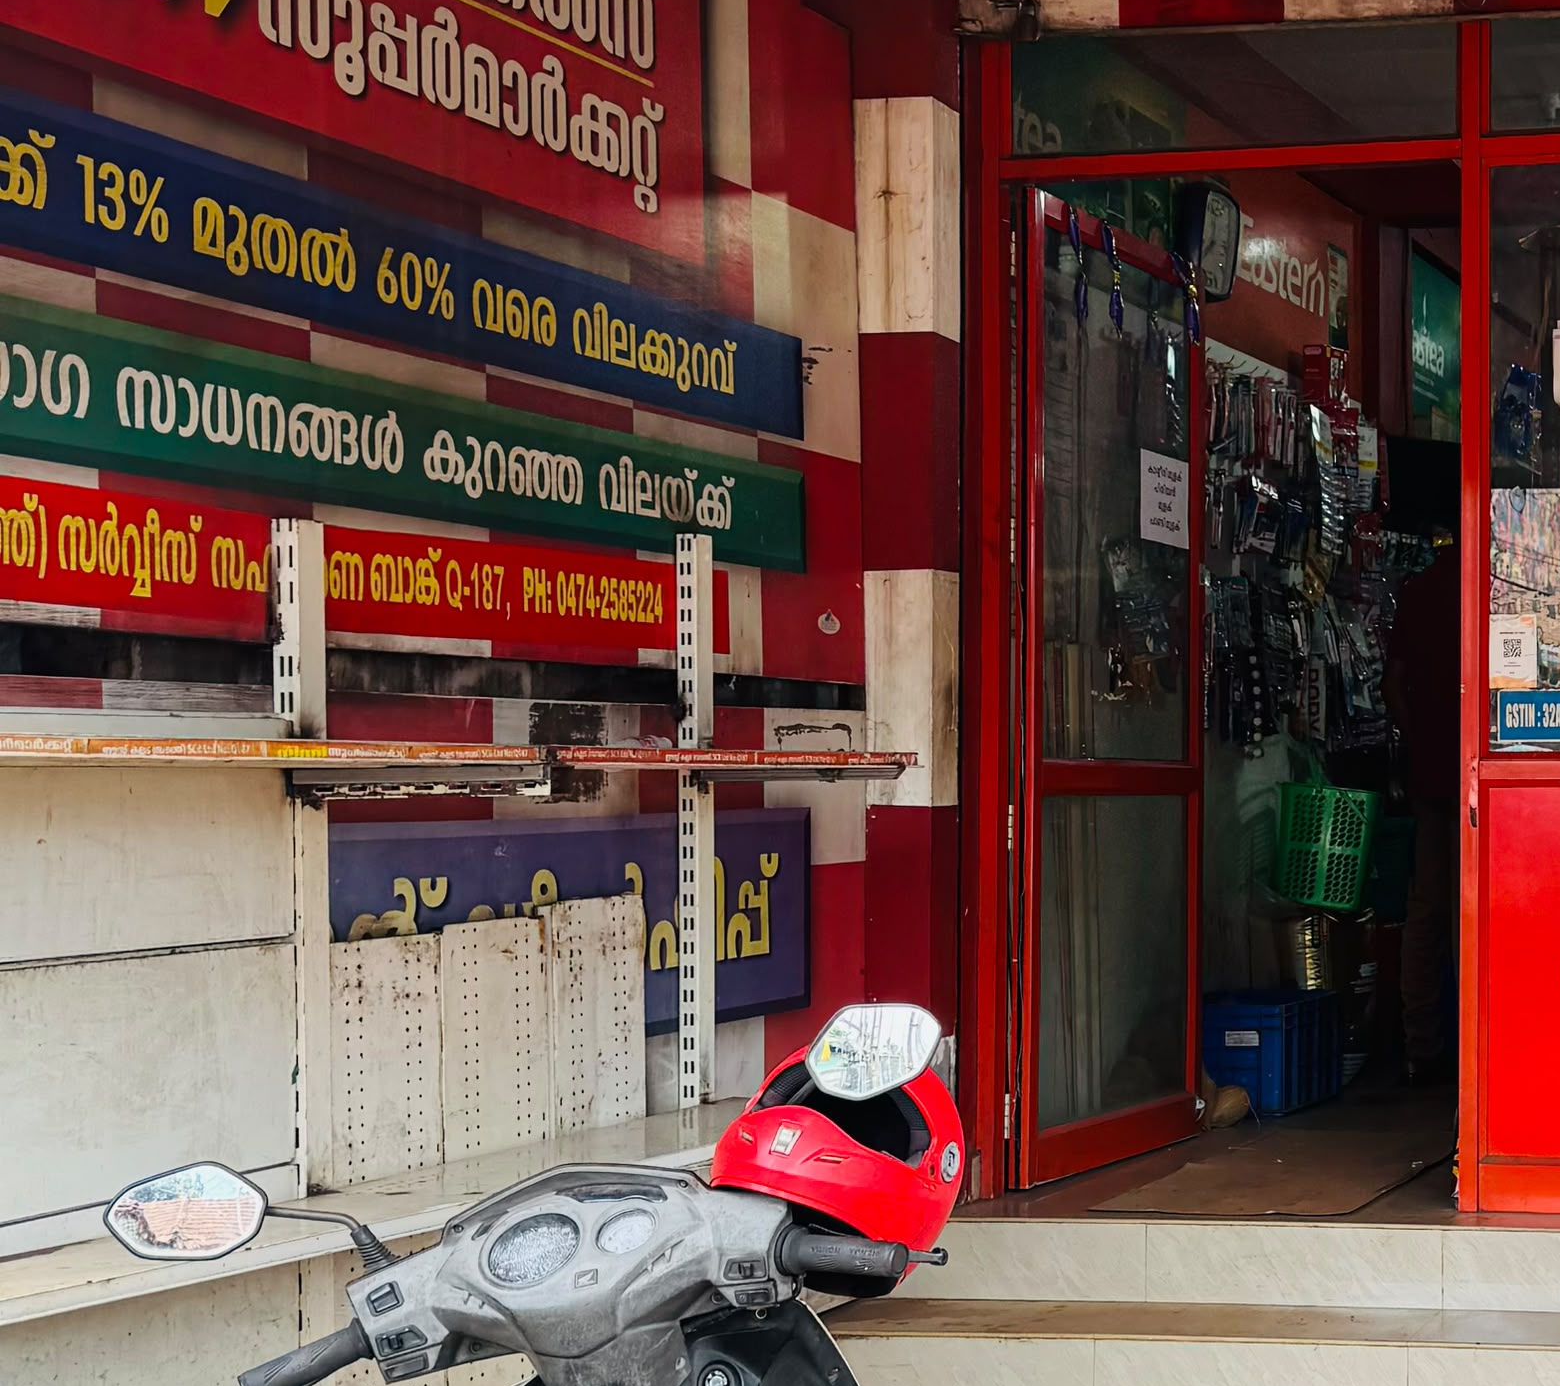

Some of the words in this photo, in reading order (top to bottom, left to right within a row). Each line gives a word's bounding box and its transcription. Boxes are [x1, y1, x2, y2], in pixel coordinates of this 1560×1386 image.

[76, 154, 169, 244] 13%
[192, 197, 357, 293] മുതൽ
[377, 246, 454, 321] 60%
[472, 278, 557, 348] വരെ
[572, 301, 737, 396] വിലക്കുറവ്
[116, 365, 404, 474] സാധനങ്ങൾ
[423, 428, 584, 506] കുറഞ്ഞ
[58, 501, 203, 598] സർവ്വീസ്
[370, 546, 442, 606] ബാങ്ക്
[523, 566, 552, 614] PH:
[556, 570, 663, 625] 0474-2585224
[1505, 703, 1535, 729] GSTIN
